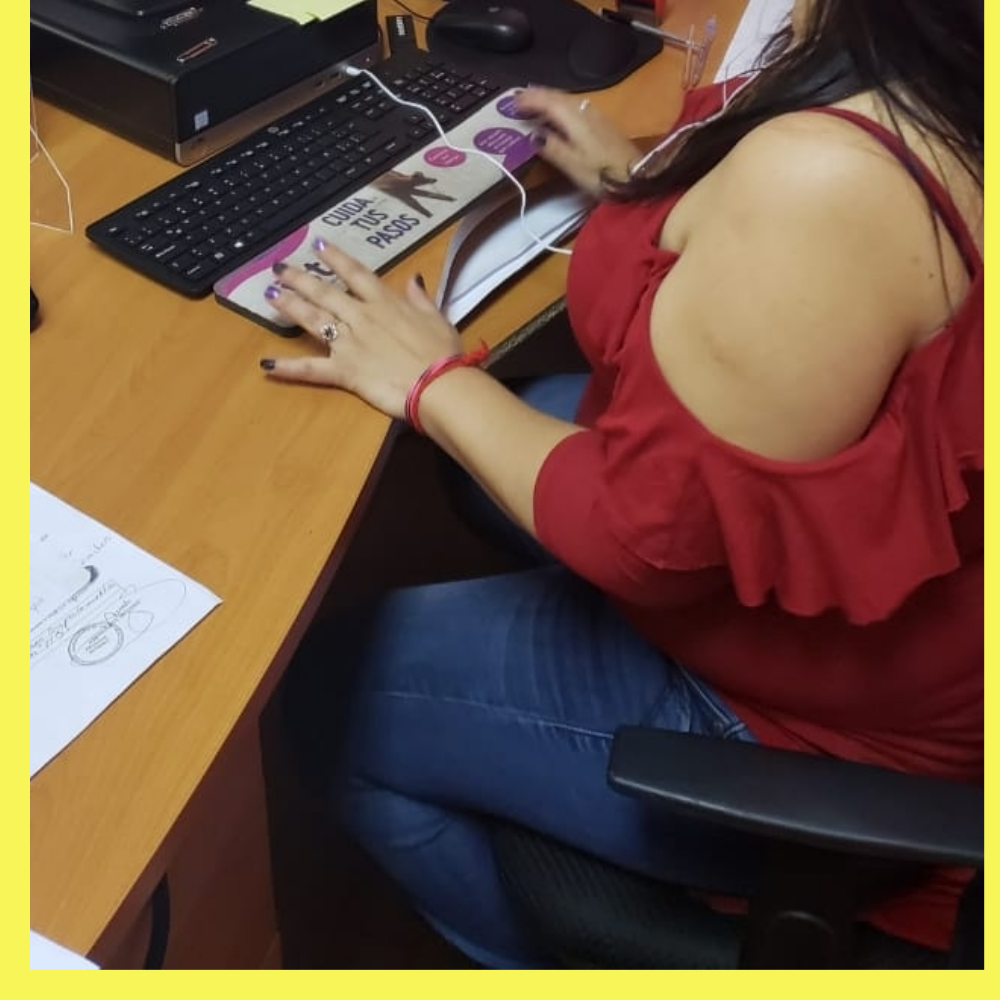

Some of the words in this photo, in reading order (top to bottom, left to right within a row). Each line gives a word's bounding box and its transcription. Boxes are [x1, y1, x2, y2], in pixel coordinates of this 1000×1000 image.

[321, 198, 374, 227] CUIDA
[350, 208, 388, 231] TUS
[365, 213, 420, 250] PASOS
